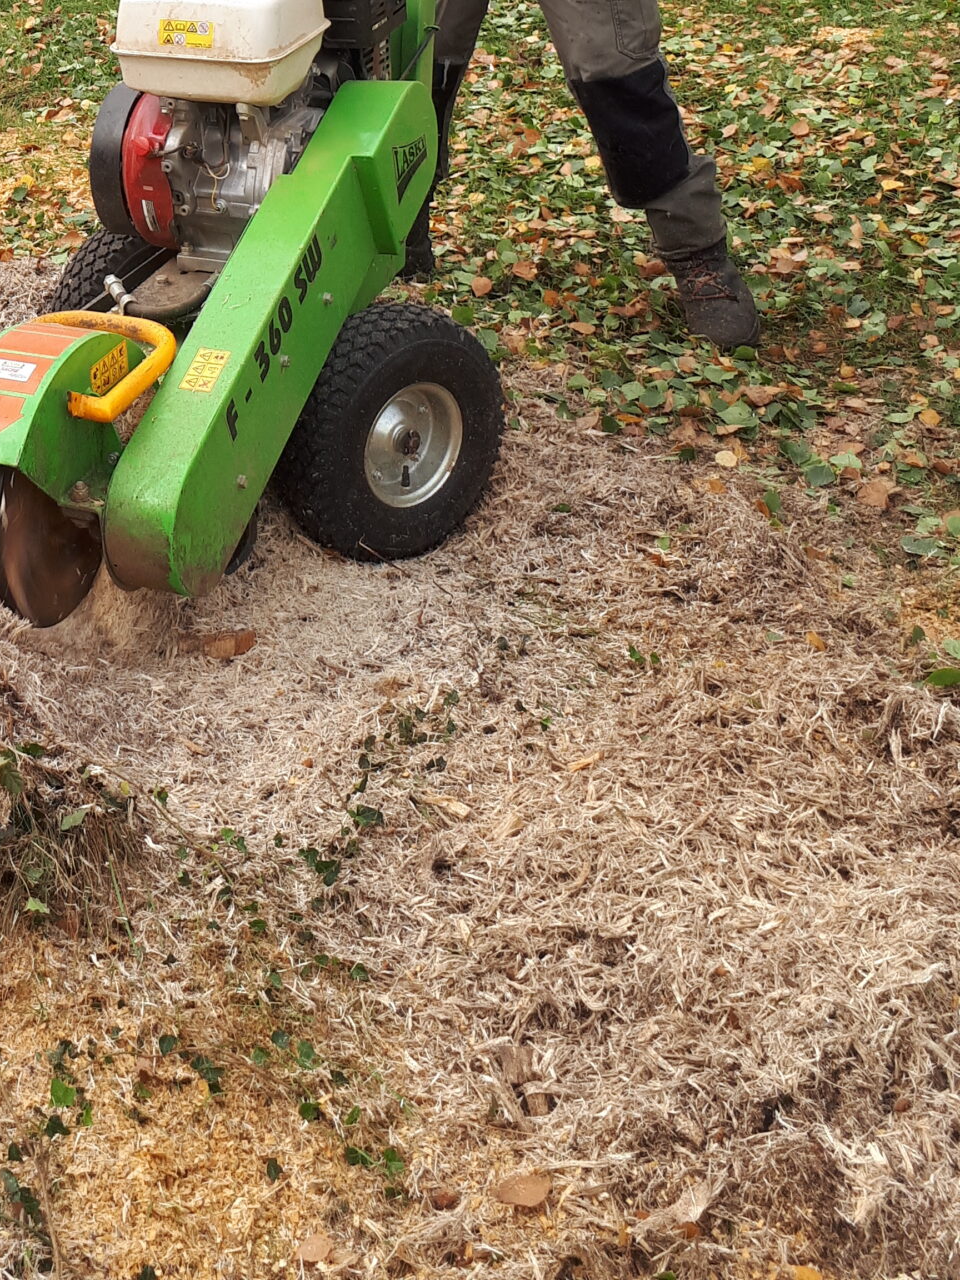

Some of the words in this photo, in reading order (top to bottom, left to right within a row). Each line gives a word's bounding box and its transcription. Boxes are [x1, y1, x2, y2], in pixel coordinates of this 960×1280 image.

[394, 138, 425, 182] LASKI
[226, 397, 239, 442] F
[253, 295, 293, 384] 360
[293, 233, 322, 305] SW
